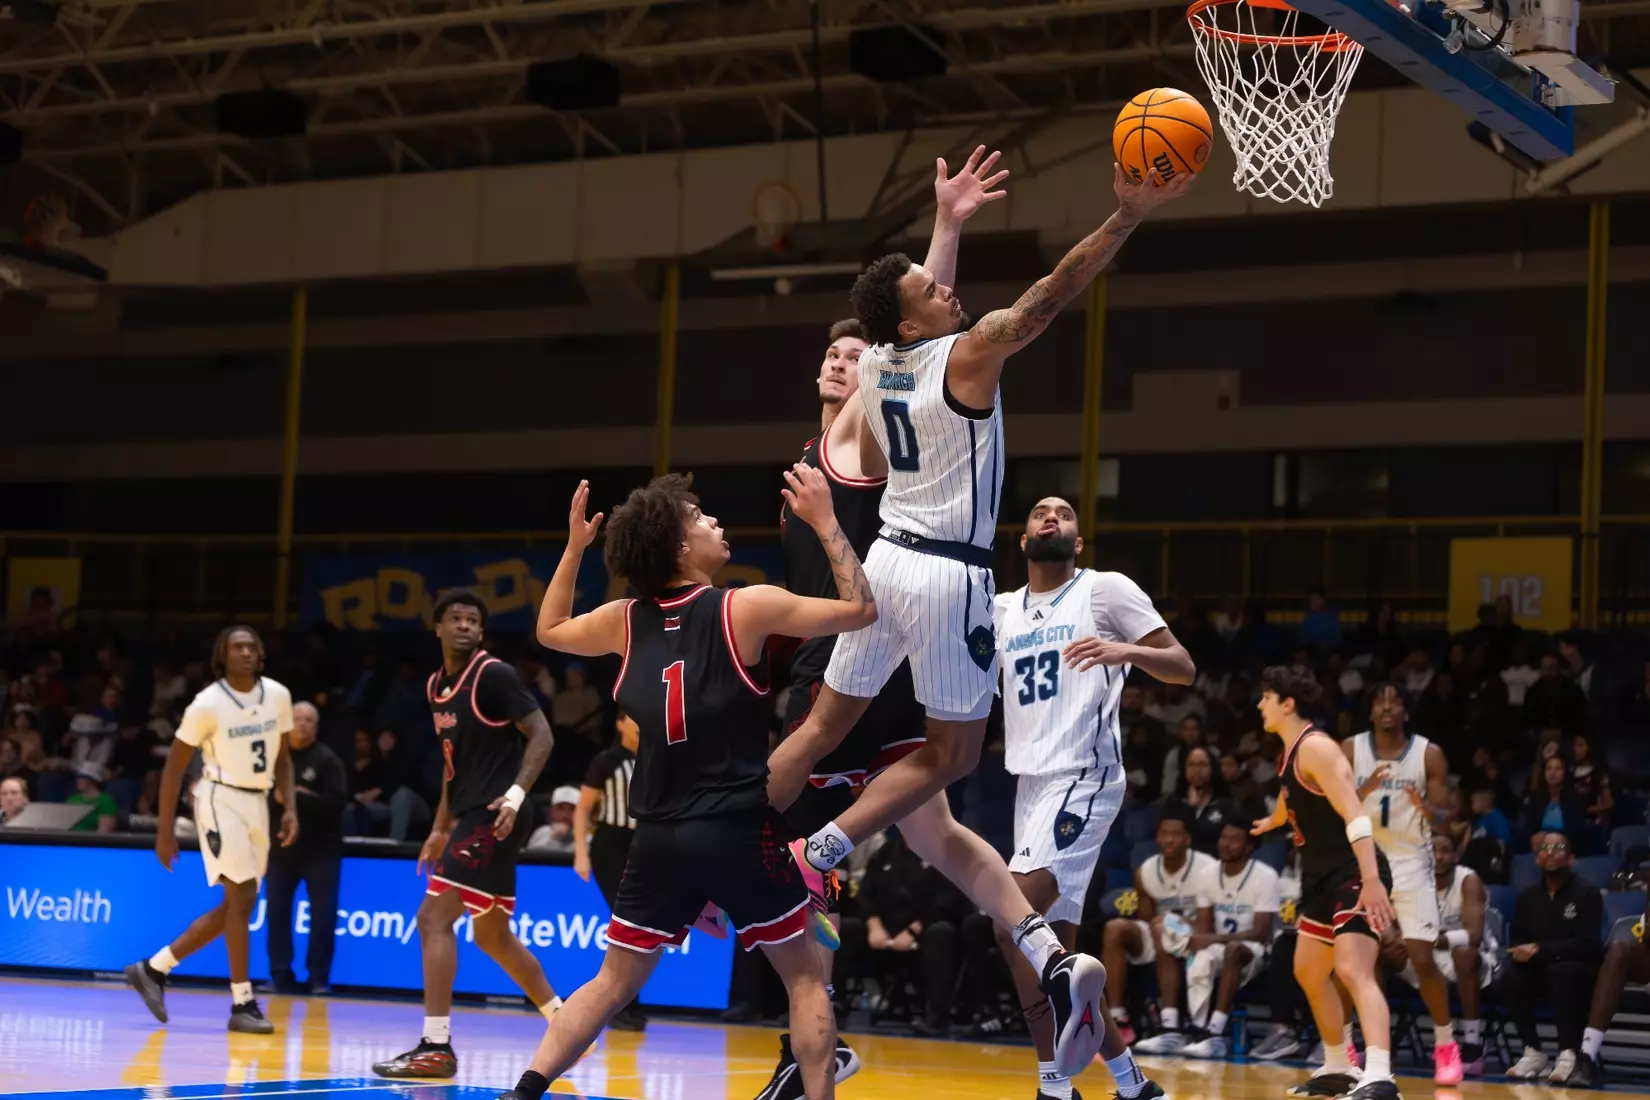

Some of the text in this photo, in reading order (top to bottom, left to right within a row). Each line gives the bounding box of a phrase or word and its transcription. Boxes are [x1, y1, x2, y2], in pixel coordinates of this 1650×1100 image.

[880, 399, 920, 472] 0
[1046, 624, 1076, 643] CITY
[1014, 649, 1060, 707] 33
[662, 660, 688, 745] 1
[251, 739, 267, 774] 3
[1379, 795, 1391, 828] 1
[7, 886, 112, 924] Wealth
